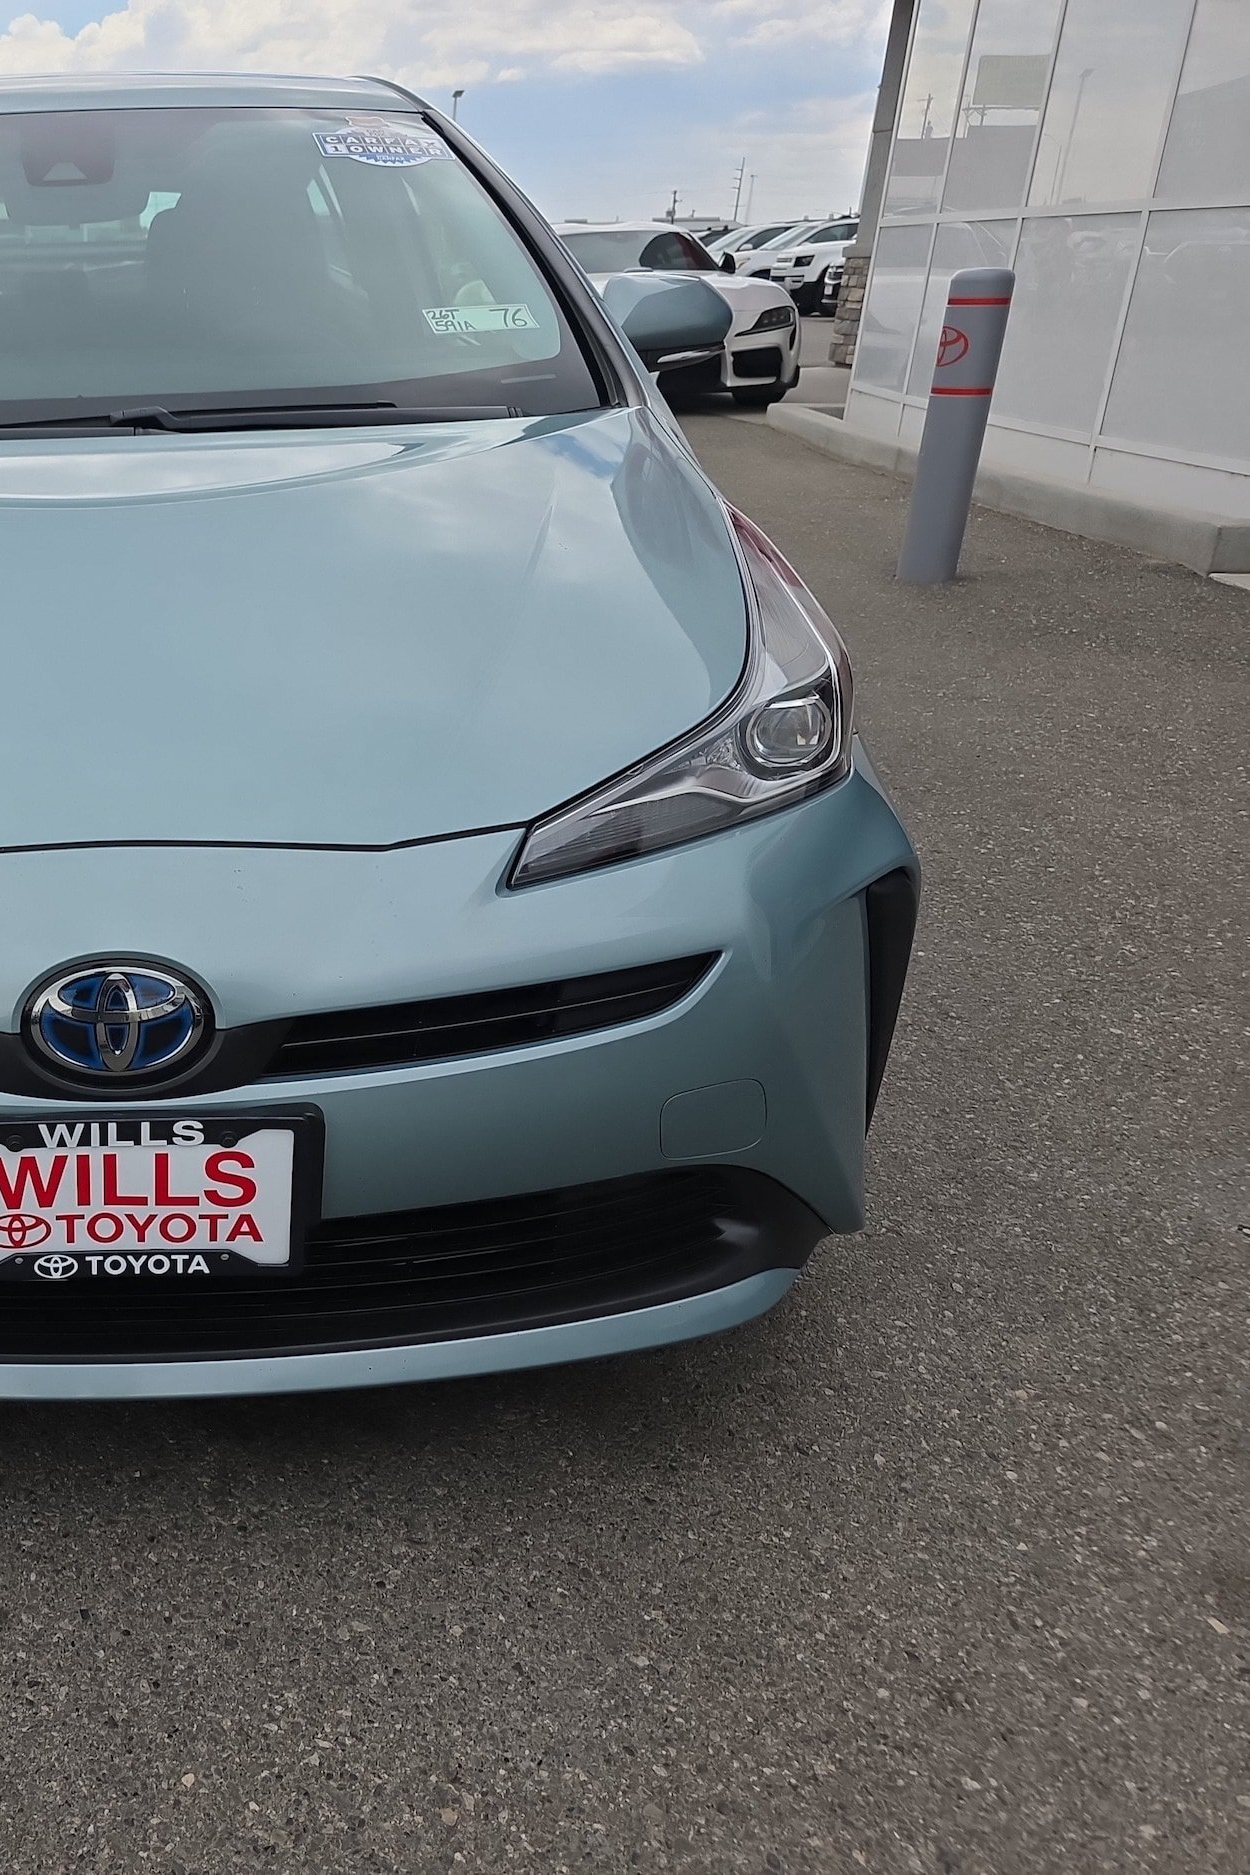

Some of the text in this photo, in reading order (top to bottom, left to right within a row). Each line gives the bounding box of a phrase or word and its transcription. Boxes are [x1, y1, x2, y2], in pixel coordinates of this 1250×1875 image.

[325, 136, 436, 146] CARFAX
[350, 146, 443, 156] OWNER
[488, 308, 528, 328] 76
[37, 1120, 205, 1148] WILLS
[55, 1213, 264, 1244] TOYOTA
[85, 1254, 211, 1275] TOYOTA
